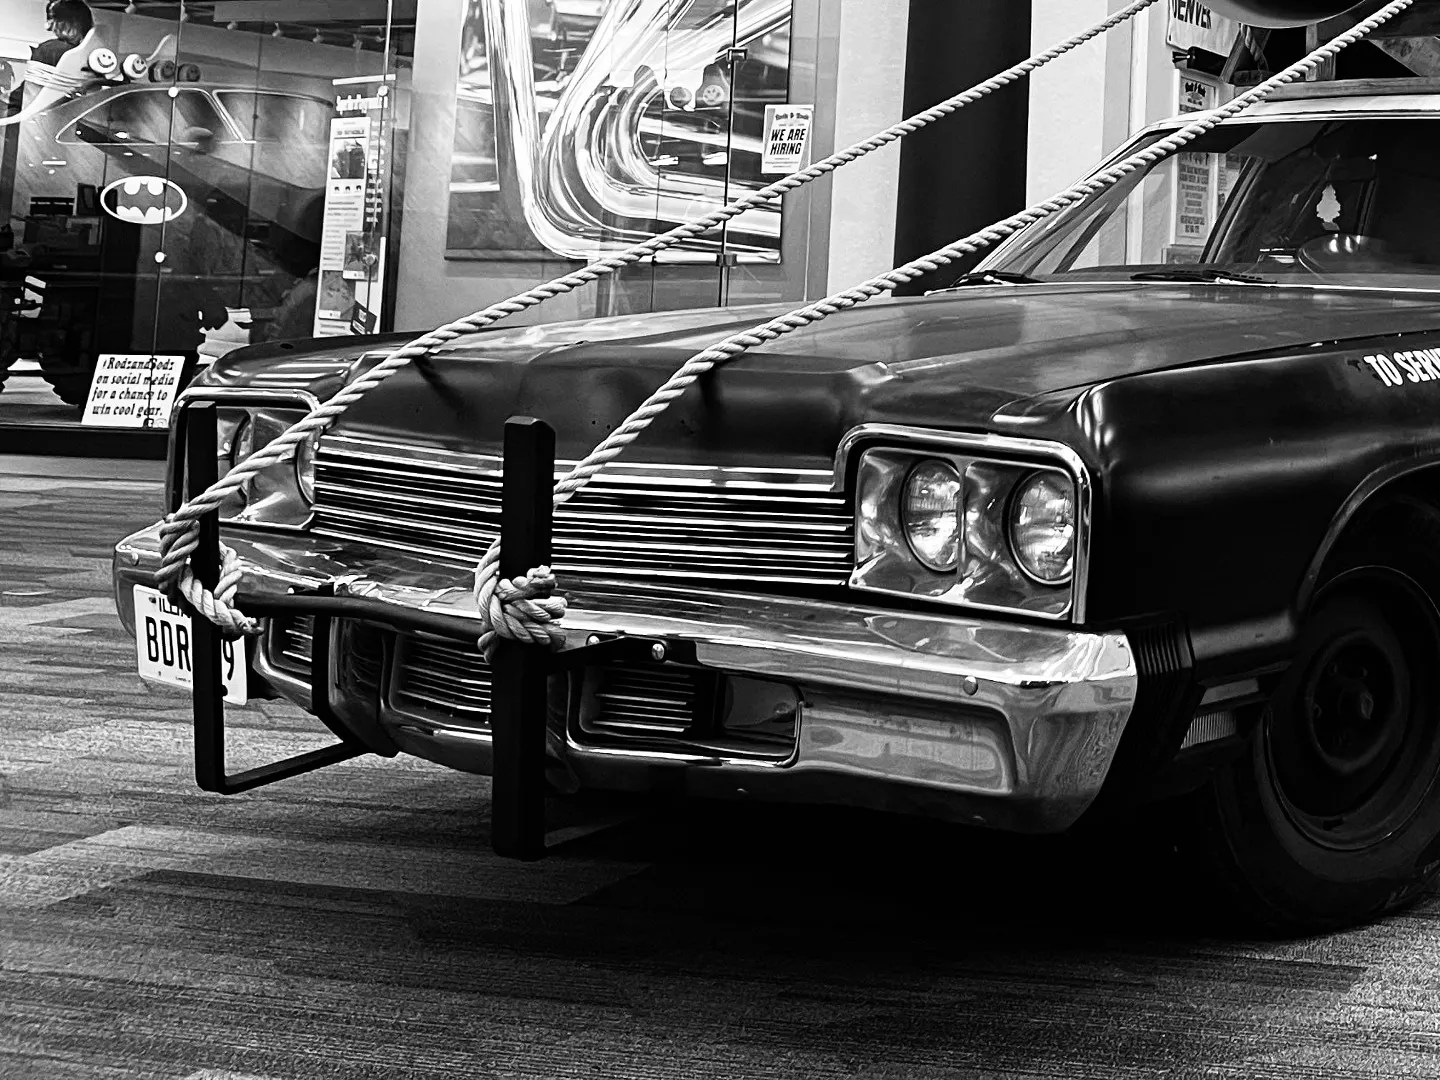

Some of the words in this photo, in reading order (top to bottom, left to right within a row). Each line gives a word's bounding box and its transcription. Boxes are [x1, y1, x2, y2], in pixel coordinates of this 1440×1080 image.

[770, 128, 786, 142] WE
[787, 128, 807, 141] ARE
[770, 142, 802, 156] HIRING
[1363, 353, 1404, 387] TO
[96, 375, 109, 385] on
[110, 372, 142, 385] social
[143, 373, 175, 385] media
[91, 386, 108, 402] for
[110, 390, 117, 400] a
[118, 387, 155, 400] chance
[156, 389, 168, 401] to
[92, 403, 111, 415] win
[113, 403, 136, 416] cool
